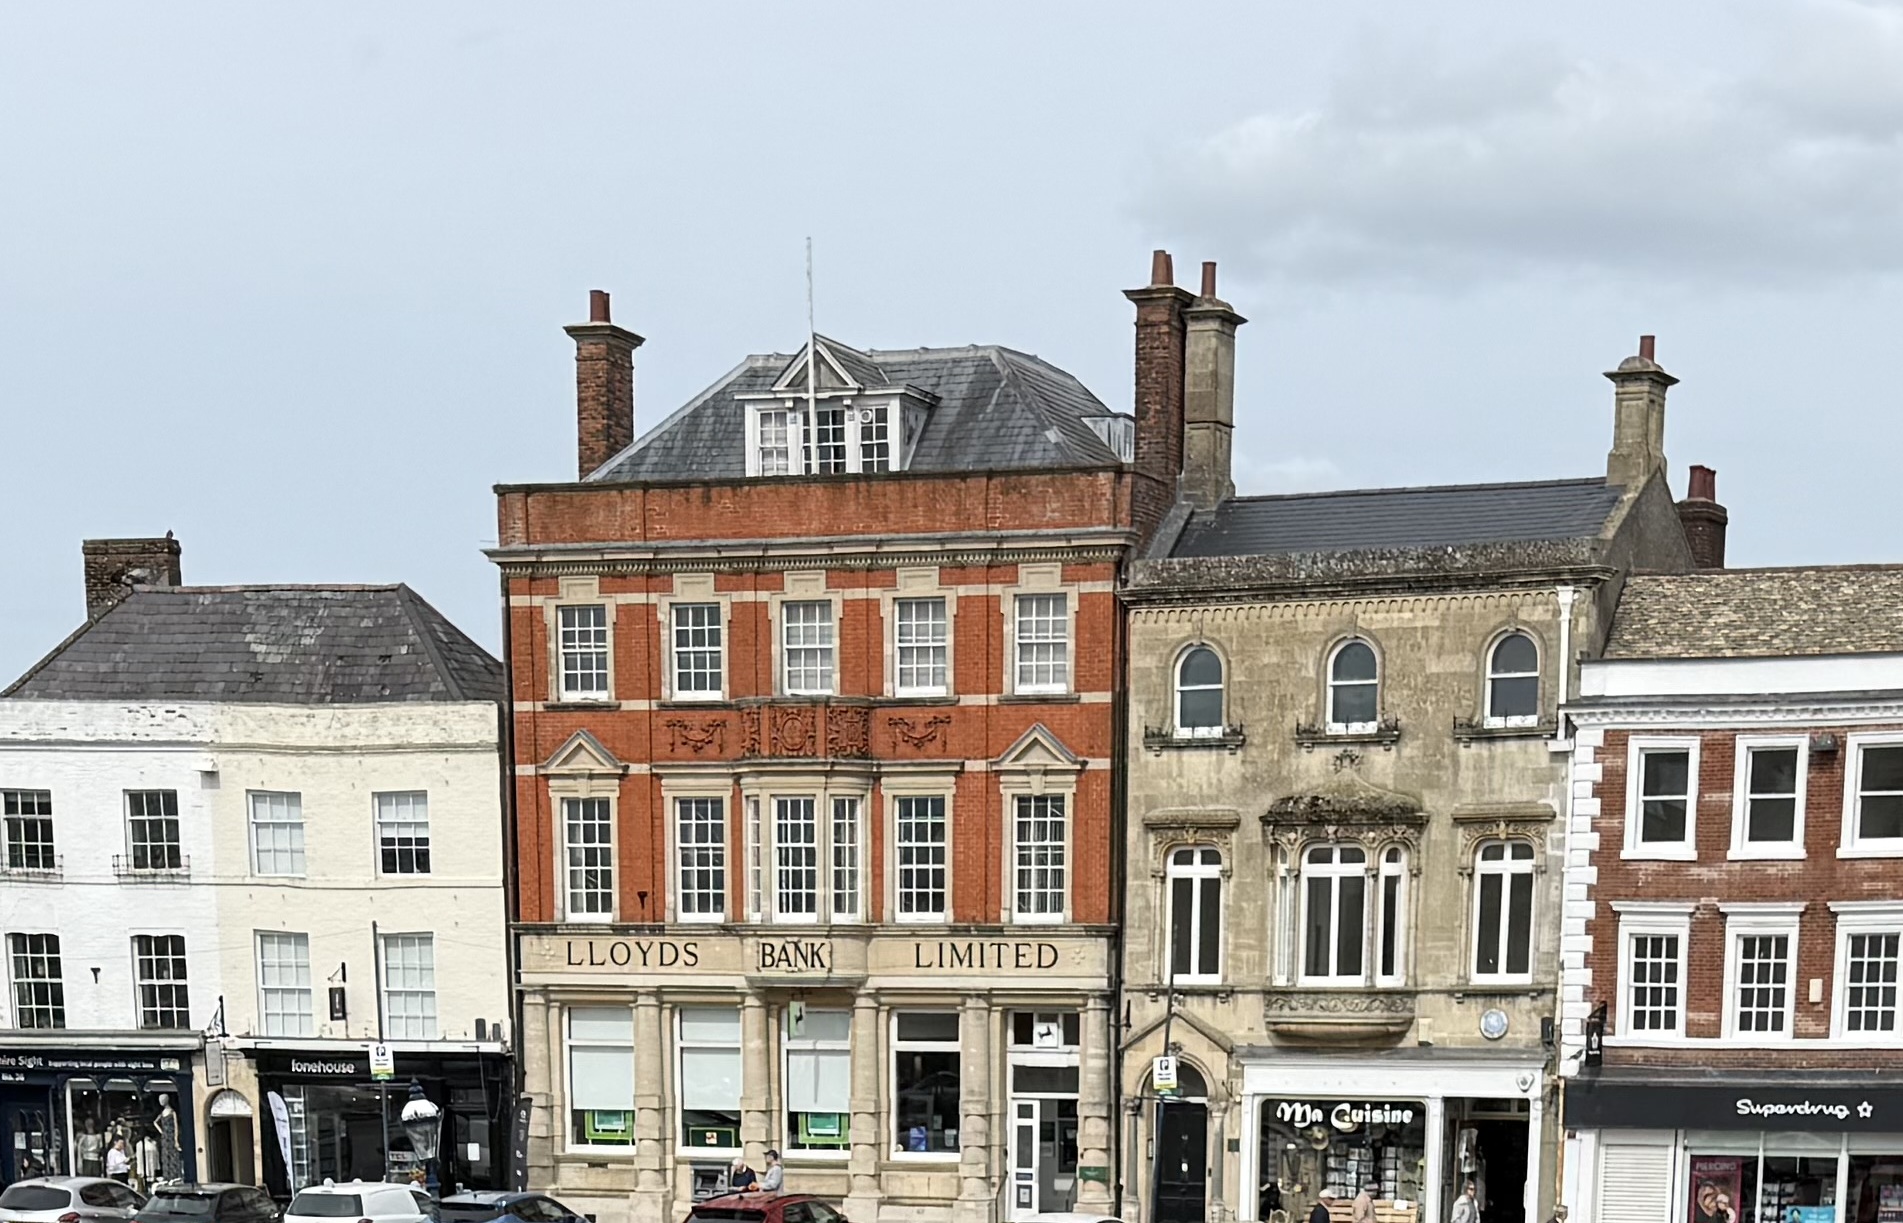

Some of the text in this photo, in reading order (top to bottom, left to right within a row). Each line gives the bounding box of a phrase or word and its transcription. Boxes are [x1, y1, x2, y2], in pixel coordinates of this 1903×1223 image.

[566, 941, 1059, 968] LLOYDS BANK LIMITED
[18, 1055, 44, 1068] Sight
[291, 1059, 355, 1074] fonehouse
[1276, 1102, 1414, 1130] Ma Cuisine
[1736, 1098, 1850, 1119] Superdrug
